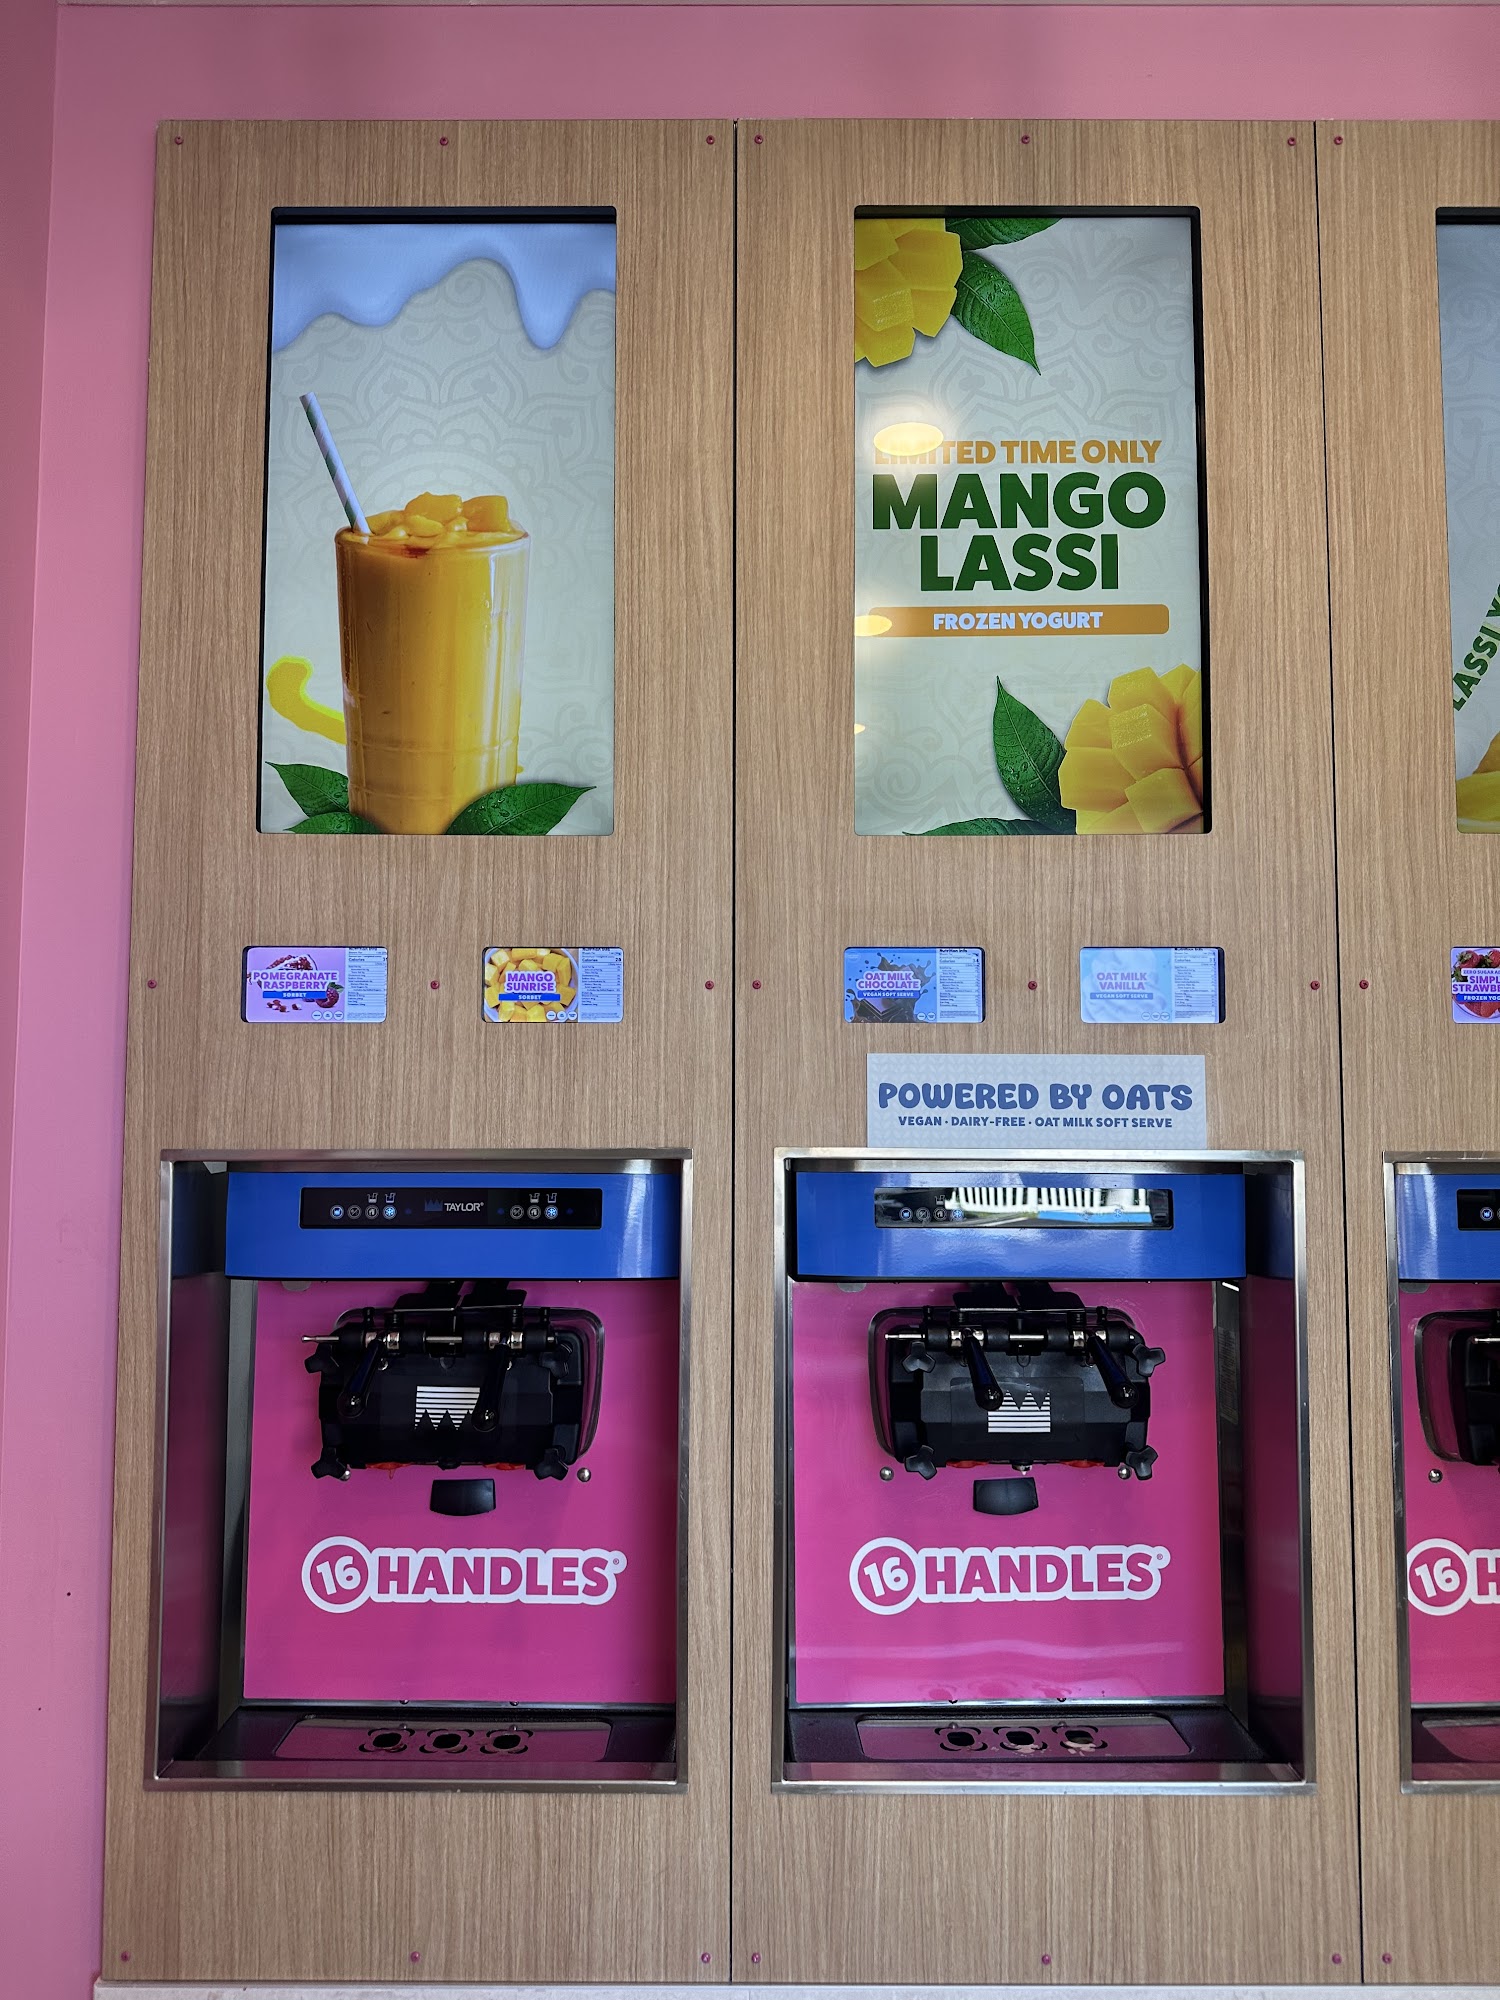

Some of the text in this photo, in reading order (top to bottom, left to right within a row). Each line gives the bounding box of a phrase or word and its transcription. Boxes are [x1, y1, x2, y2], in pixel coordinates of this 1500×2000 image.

[1001, 440, 1077, 464] TIME
[1081, 439, 1162, 464] ONLY
[872, 471, 1167, 529] MANGO
[920, 533, 1119, 591] LASSI
[933, 611, 1103, 630] FROZEN YOGURT
[253, 972, 338, 981] POMEGRANATE
[507, 973, 553, 982] MANGO
[865, 972, 912, 980] OAT MILK
[1096, 972, 1147, 981] OAT MILK
[263, 981, 328, 990] RASPBERRY
[506, 982, 554, 991] SUNRISE
[857, 980, 920, 989] CHOCOLATE
[1099, 981, 1146, 990] VANILLA
[878, 1082, 1193, 1111] POWERED BY OATS
[898, 1116, 1172, 1128] VEGAN DAIRY-FREE OAT MILK SOFT SERVE
[316, 1556, 361, 1595] 16
[863, 1556, 909, 1597] 16
[1415, 1558, 1460, 1598] 16
